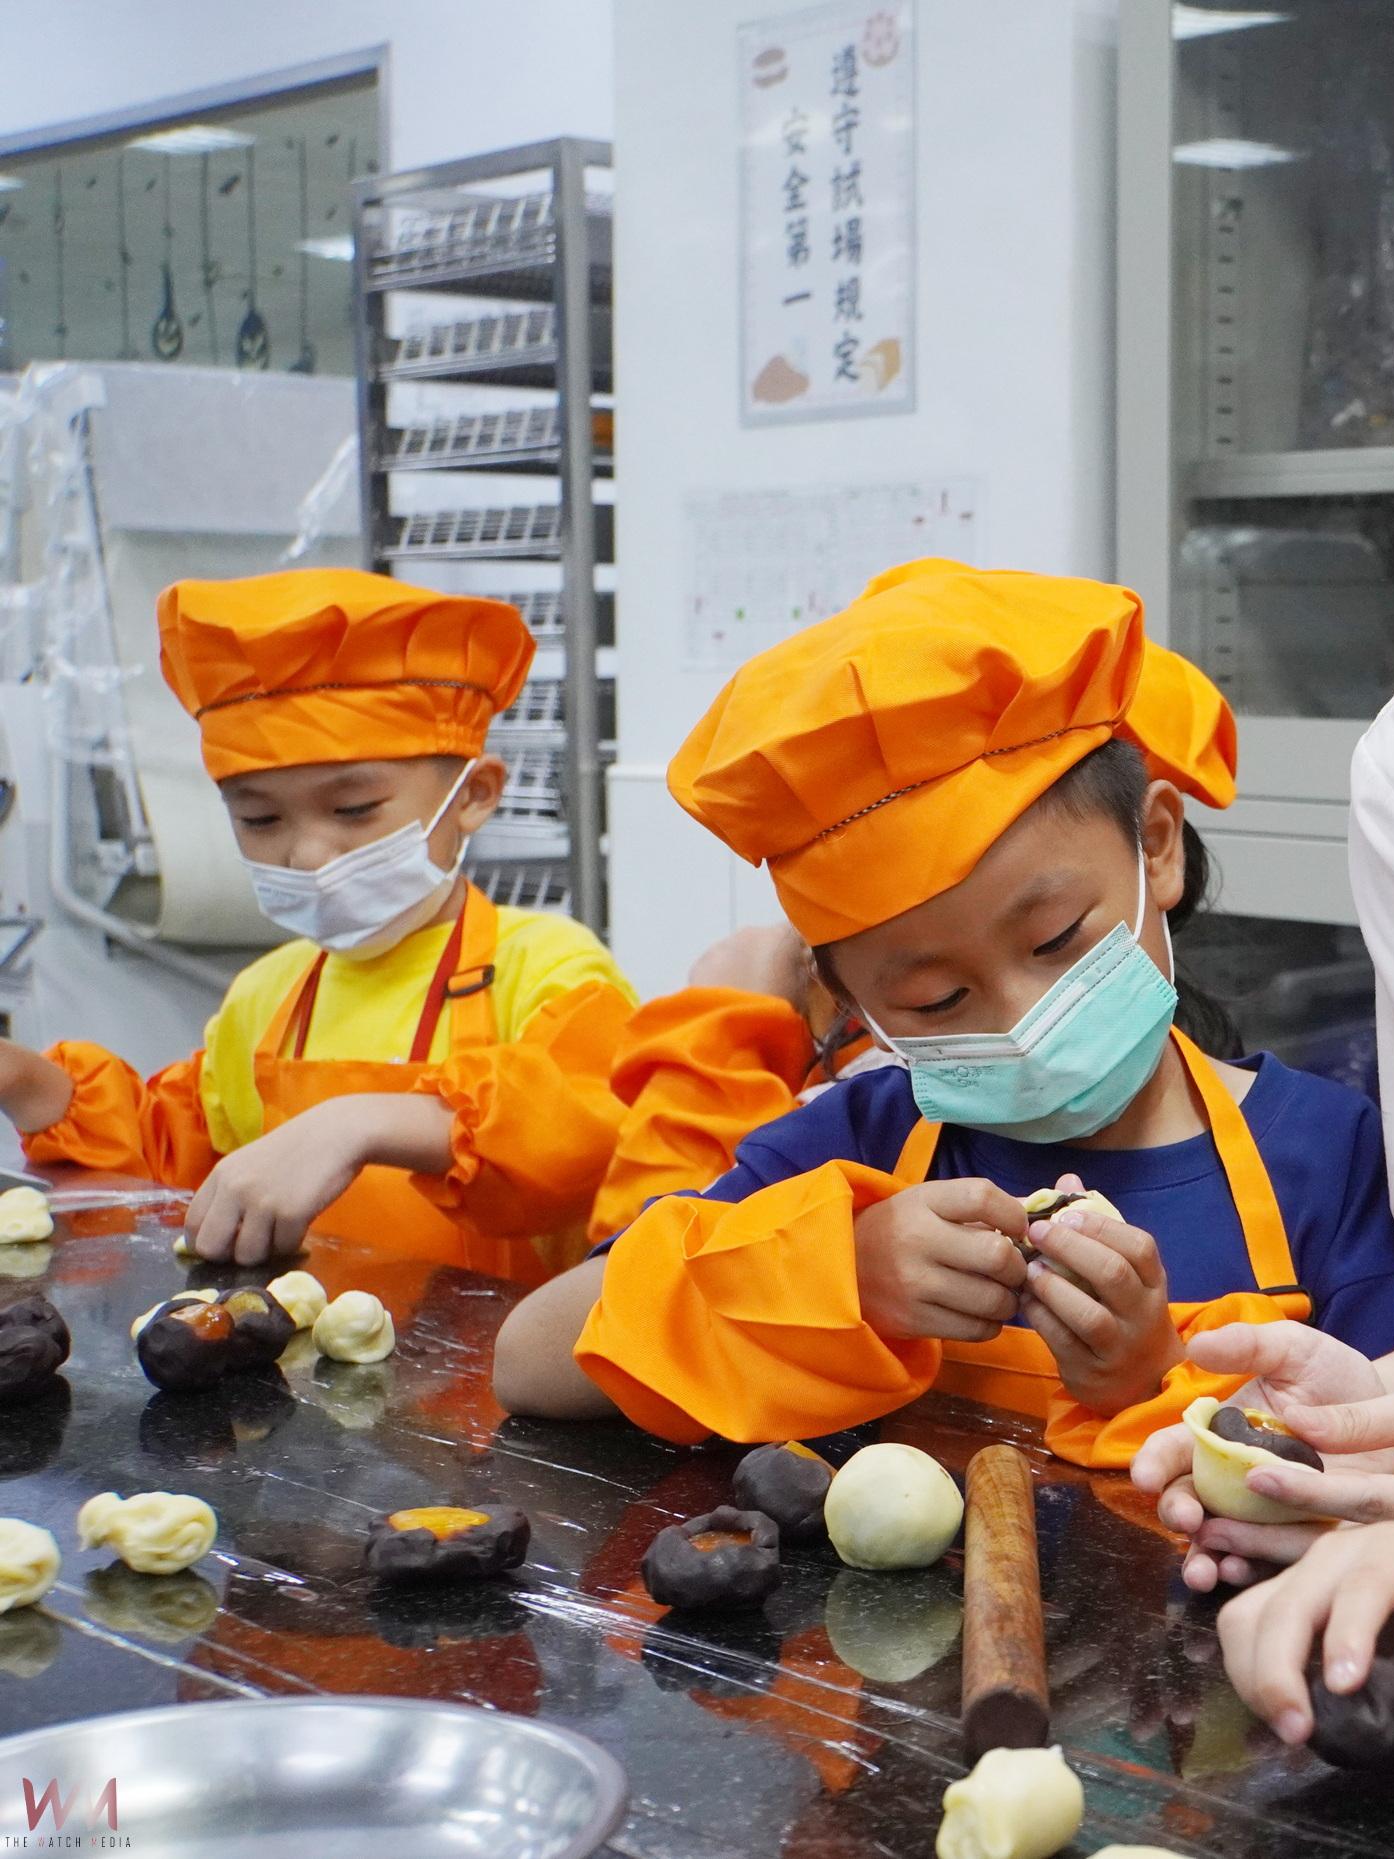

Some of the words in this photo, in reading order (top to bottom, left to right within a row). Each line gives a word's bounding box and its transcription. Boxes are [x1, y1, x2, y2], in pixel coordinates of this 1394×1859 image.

[782, 107, 812, 305] 安全第一
[830, 44, 863, 382] 遵守試場規定
